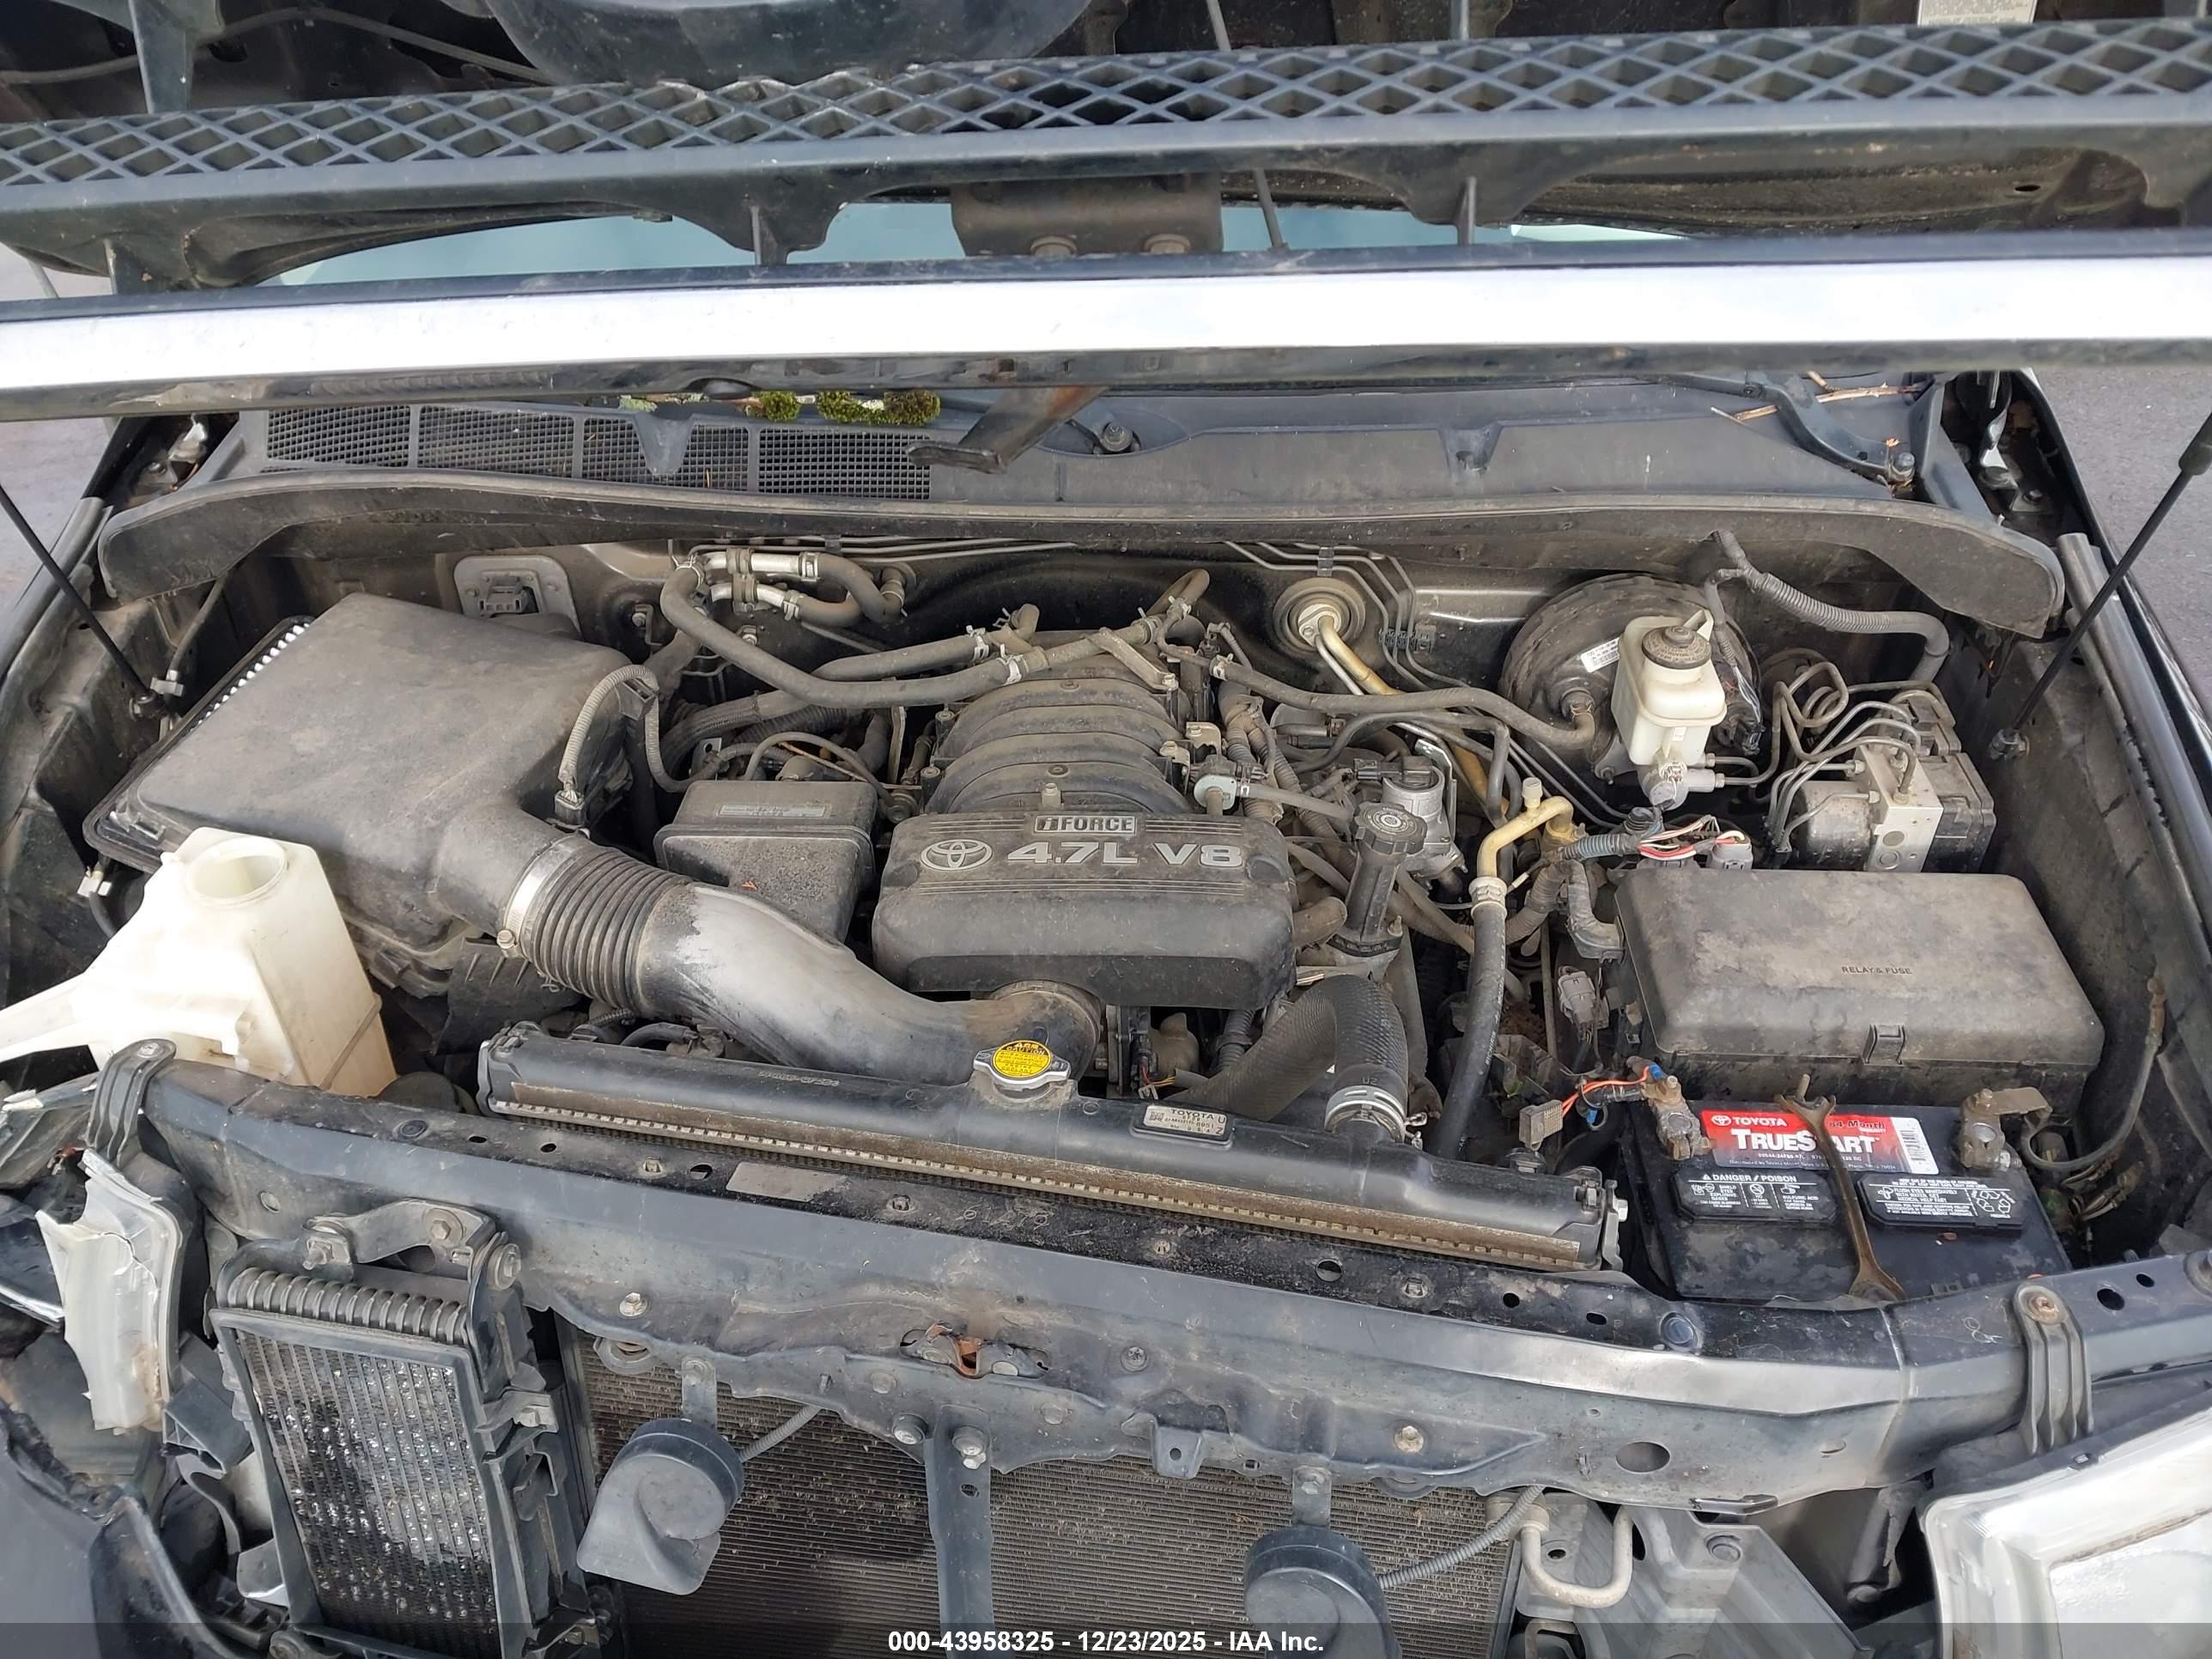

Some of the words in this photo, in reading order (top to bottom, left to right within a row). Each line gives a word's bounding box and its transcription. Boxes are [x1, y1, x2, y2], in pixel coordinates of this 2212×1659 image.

[1007, 842, 1139, 865] 4.7L
[1153, 843, 1243, 867] V8
[1006, 1046, 1047, 1055] CAUTION
[1170, 1109, 1214, 1120] TOYOTA
[1731, 1116, 1788, 1127] TOYOTA
[1847, 1119, 1887, 1129] Month
[1711, 1174, 1753, 1182] DANGER
[1760, 1175, 1798, 1183] POISON
